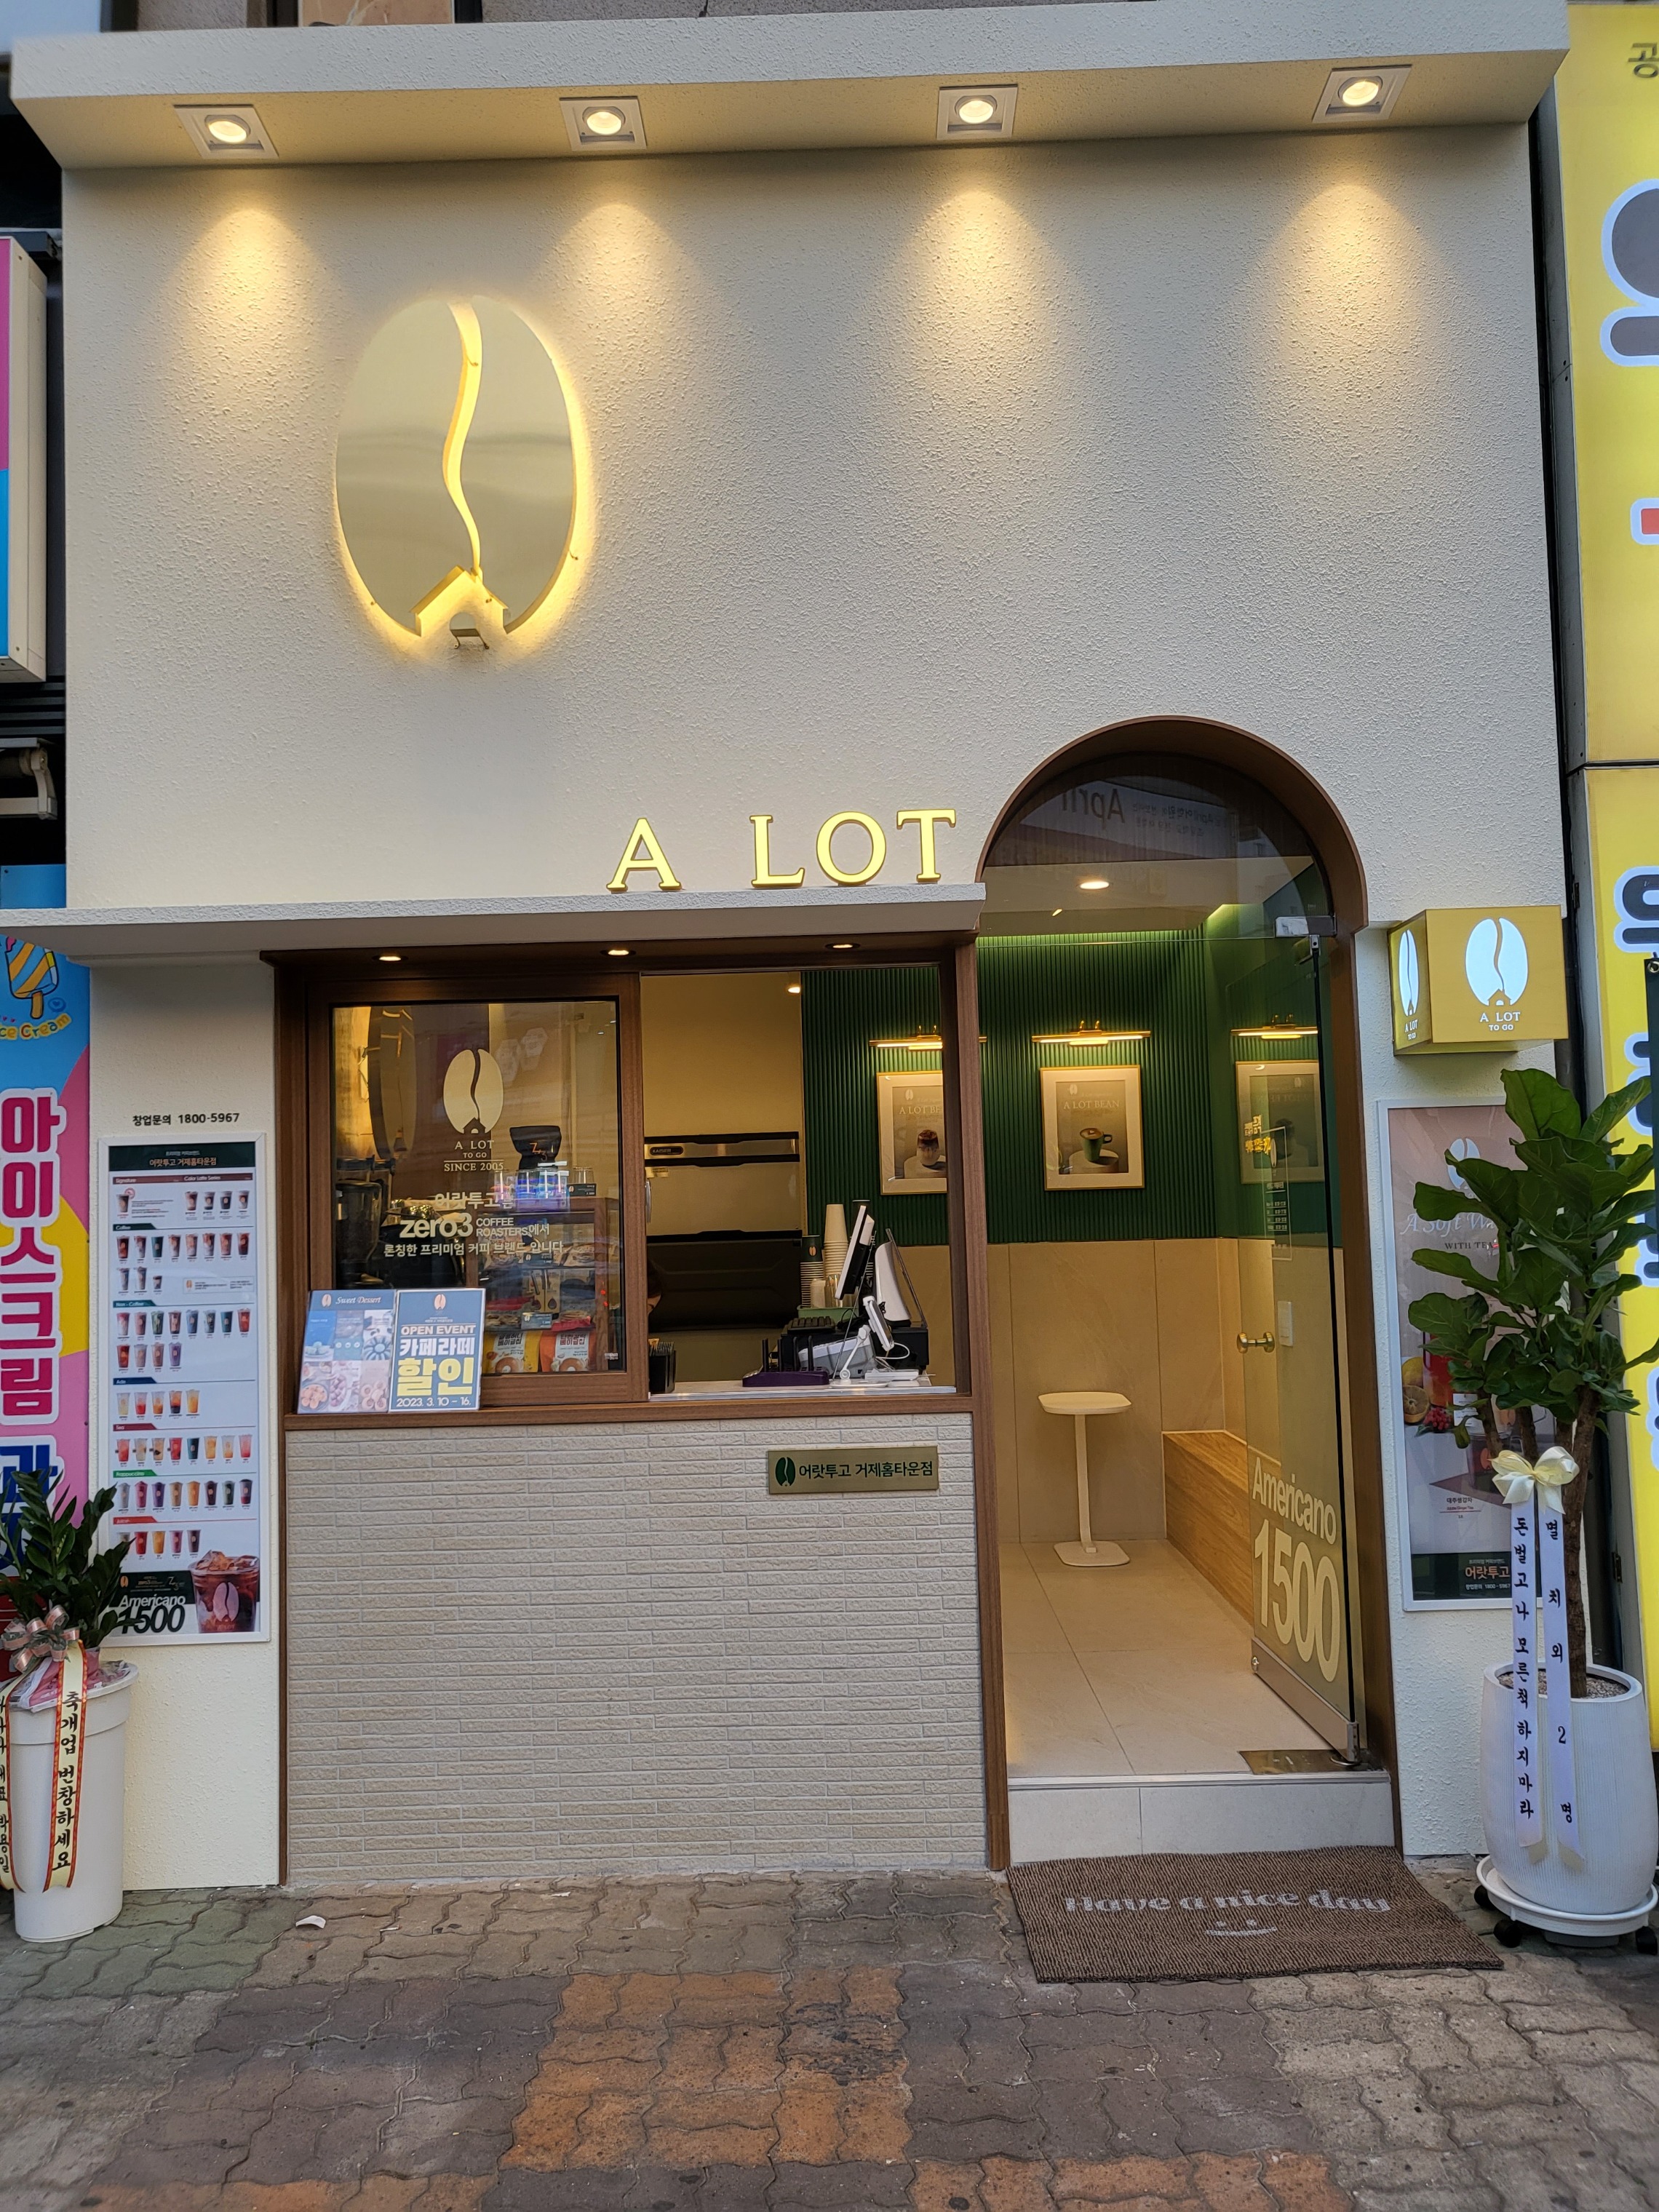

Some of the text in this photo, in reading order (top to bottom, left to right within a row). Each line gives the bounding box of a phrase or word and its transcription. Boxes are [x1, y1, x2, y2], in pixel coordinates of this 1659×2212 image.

[606, 808, 955, 891] A LOT
[1479, 1011, 1521, 1022] A LOT
[0, 1014, 71, 1041] ce Cream
[1404, 1019, 1418, 1033] A LOT
[899, 1105, 943, 1115] A LOT BE
[1063, 1099, 1120, 1110] A LOT BEAN
[132, 1113, 240, 1126] 창업문의 1800-5967
[454, 1140, 495, 1150] A LOT
[444, 1162, 504, 1171] SINCE 2005
[399, 1212, 473, 1238] zero3
[476, 1217, 514, 1227] COFFEE
[1399, 1212, 1418, 1236] A
[476, 1223, 549, 1237] ROASTERS 에서
[383, 1241, 564, 1257] 론칭한 프리미엄 커피 브랜드 입니다
[1444, 1241, 1471, 1250] WITH
[0, 1096, 60, 1419] 아이스크림
[335, 1296, 381, 1305] Sweet Dessert
[401, 1324, 477, 1336] OPEN EVENT
[397, 1358, 474, 1396] 할인
[396, 1398, 424, 1407] 2023.
[426, 1398, 434, 1407] 3.
[437, 1397, 449, 1406] 10
[460, 1396, 472, 1406] 16.
[799, 1460, 933, 1479] 어랏투고 거제홈타운점
[1252, 1457, 1337, 1545] Americano
[1465, 1565, 1511, 1580] 어랏투고
[119, 1594, 186, 1607] Americano
[1254, 1519, 1340, 1682] 1500
[119, 1604, 186, 1634] 1500
[1065, 1889, 1391, 1913] Have a nice day
